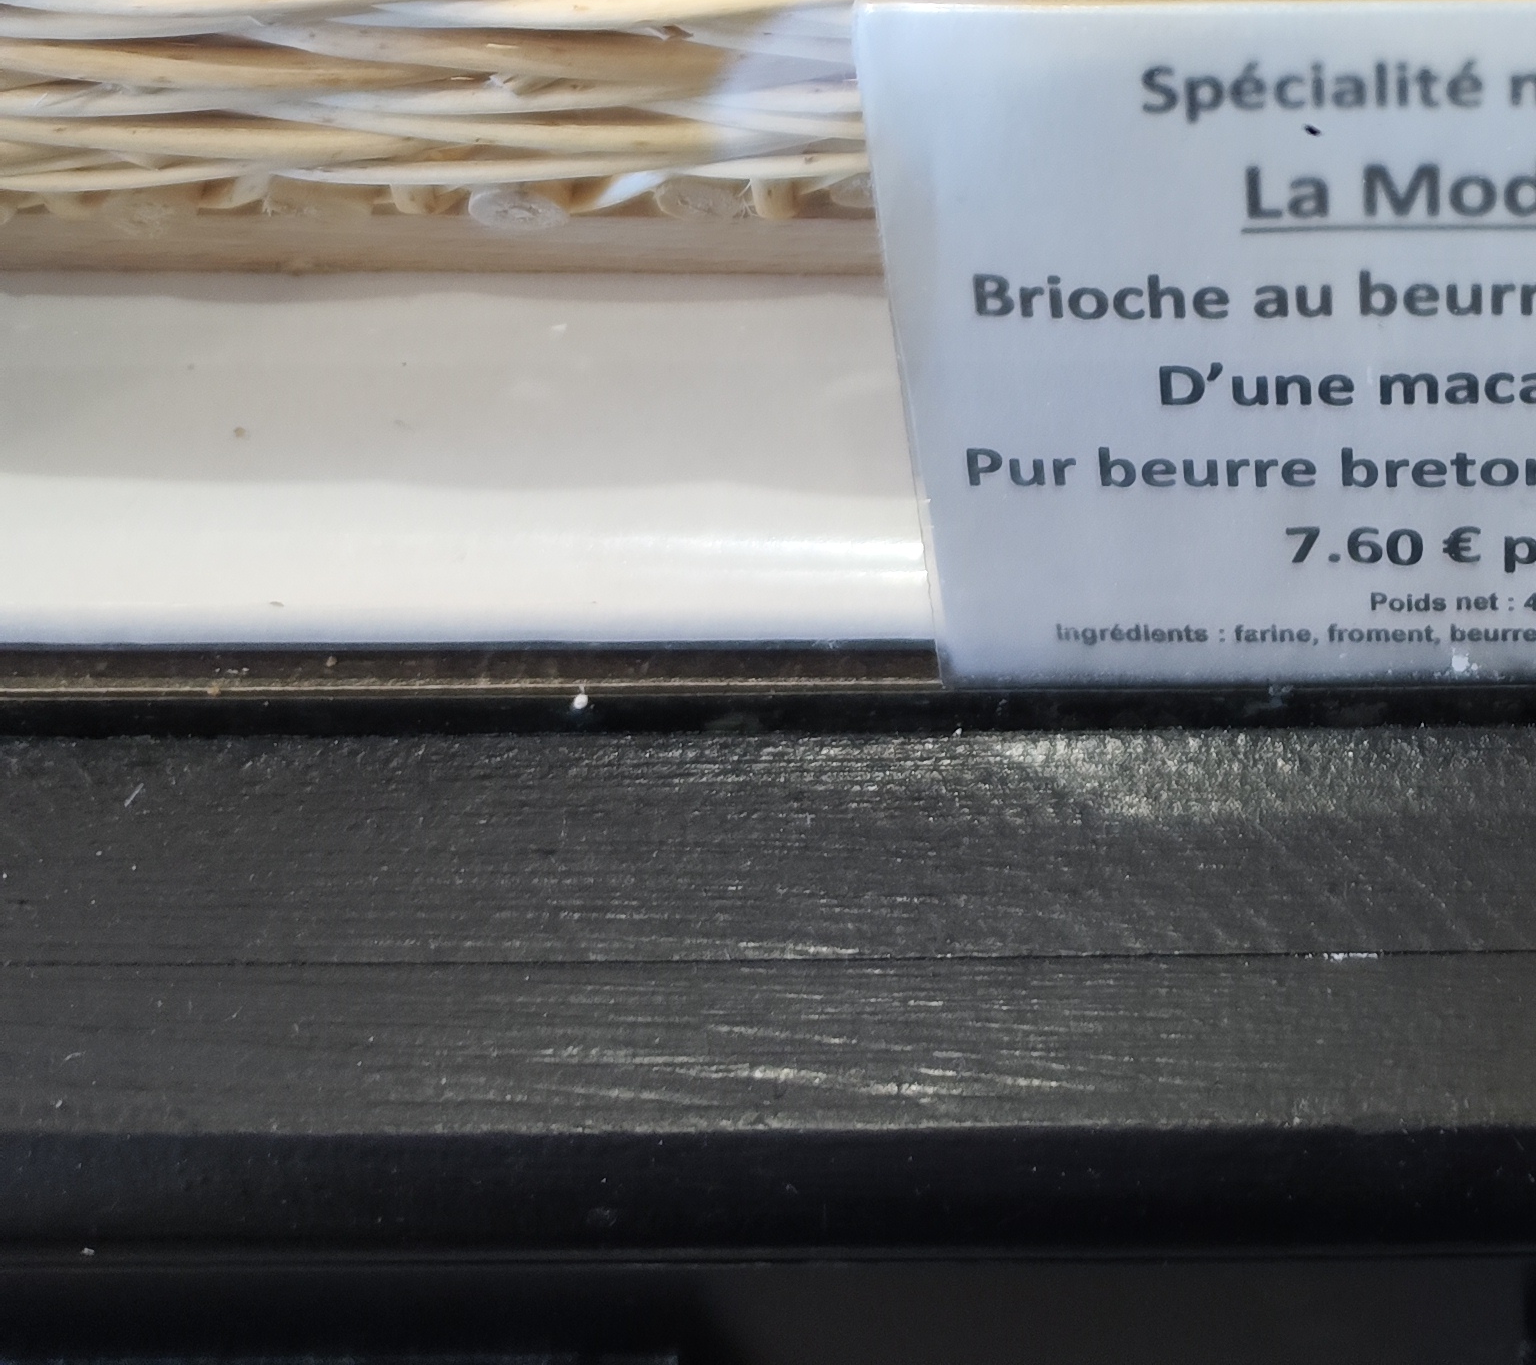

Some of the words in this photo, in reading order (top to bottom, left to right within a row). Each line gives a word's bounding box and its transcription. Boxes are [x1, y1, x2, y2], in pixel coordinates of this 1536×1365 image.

[1140, 58, 1484, 119] Spécialité
[1244, 165, 1330, 221] La
[972, 273, 1231, 321] Brioche
[1253, 280, 1333, 320] au
[965, 447, 1077, 488] Pur
[1097, 446, 1317, 489] beurre
[1285, 526, 1424, 567] 7.60
[1442, 525, 1482, 566] €
[1370, 591, 1447, 613] Poids
[1456, 593, 1498, 612] net
[1056, 623, 1208, 647] Ingrédients
[1234, 624, 1319, 647] farine,
[1327, 623, 1441, 647] froment,
